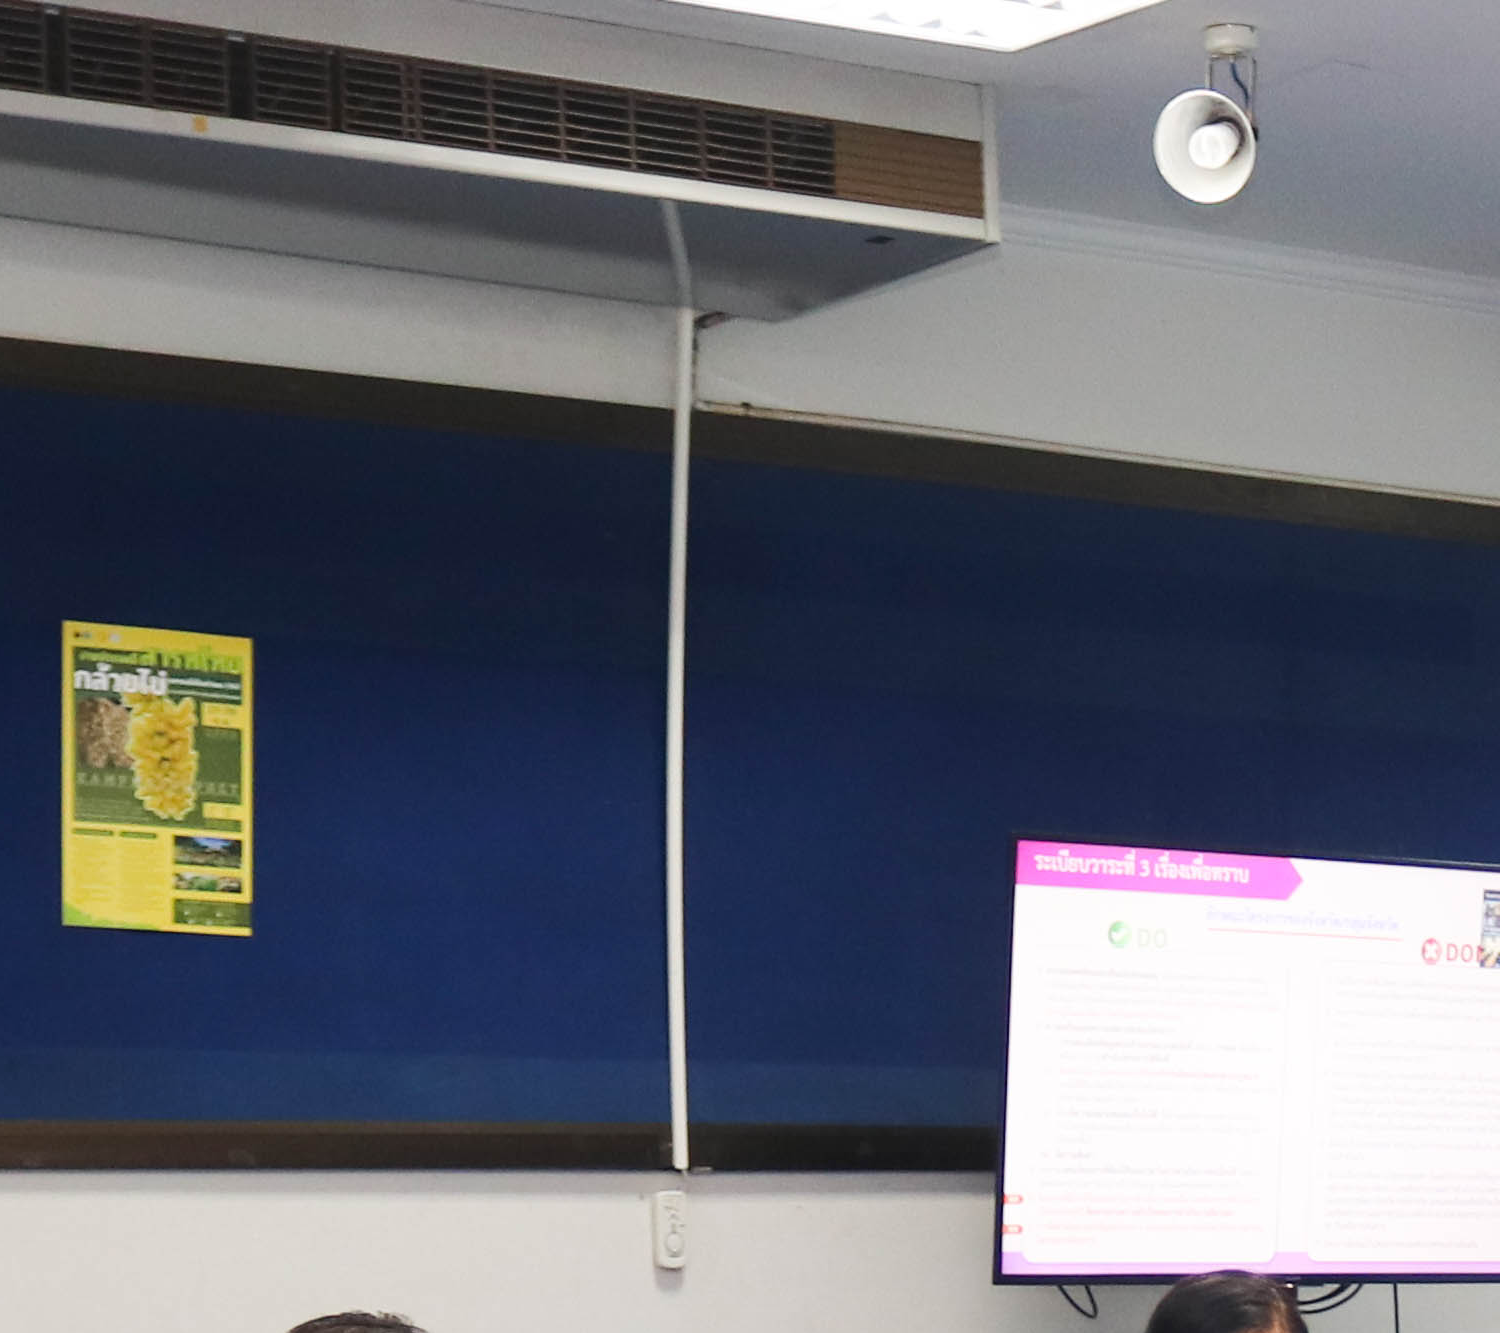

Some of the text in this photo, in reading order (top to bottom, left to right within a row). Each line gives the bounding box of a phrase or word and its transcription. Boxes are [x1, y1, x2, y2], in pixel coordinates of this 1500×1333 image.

[73, 662, 169, 697] กล้วยไข่
[1033, 849, 1250, 885] ระเบียบวาระที่ 3 เรื่องเพื่อทราบ
[1139, 927, 1168, 949] DO
